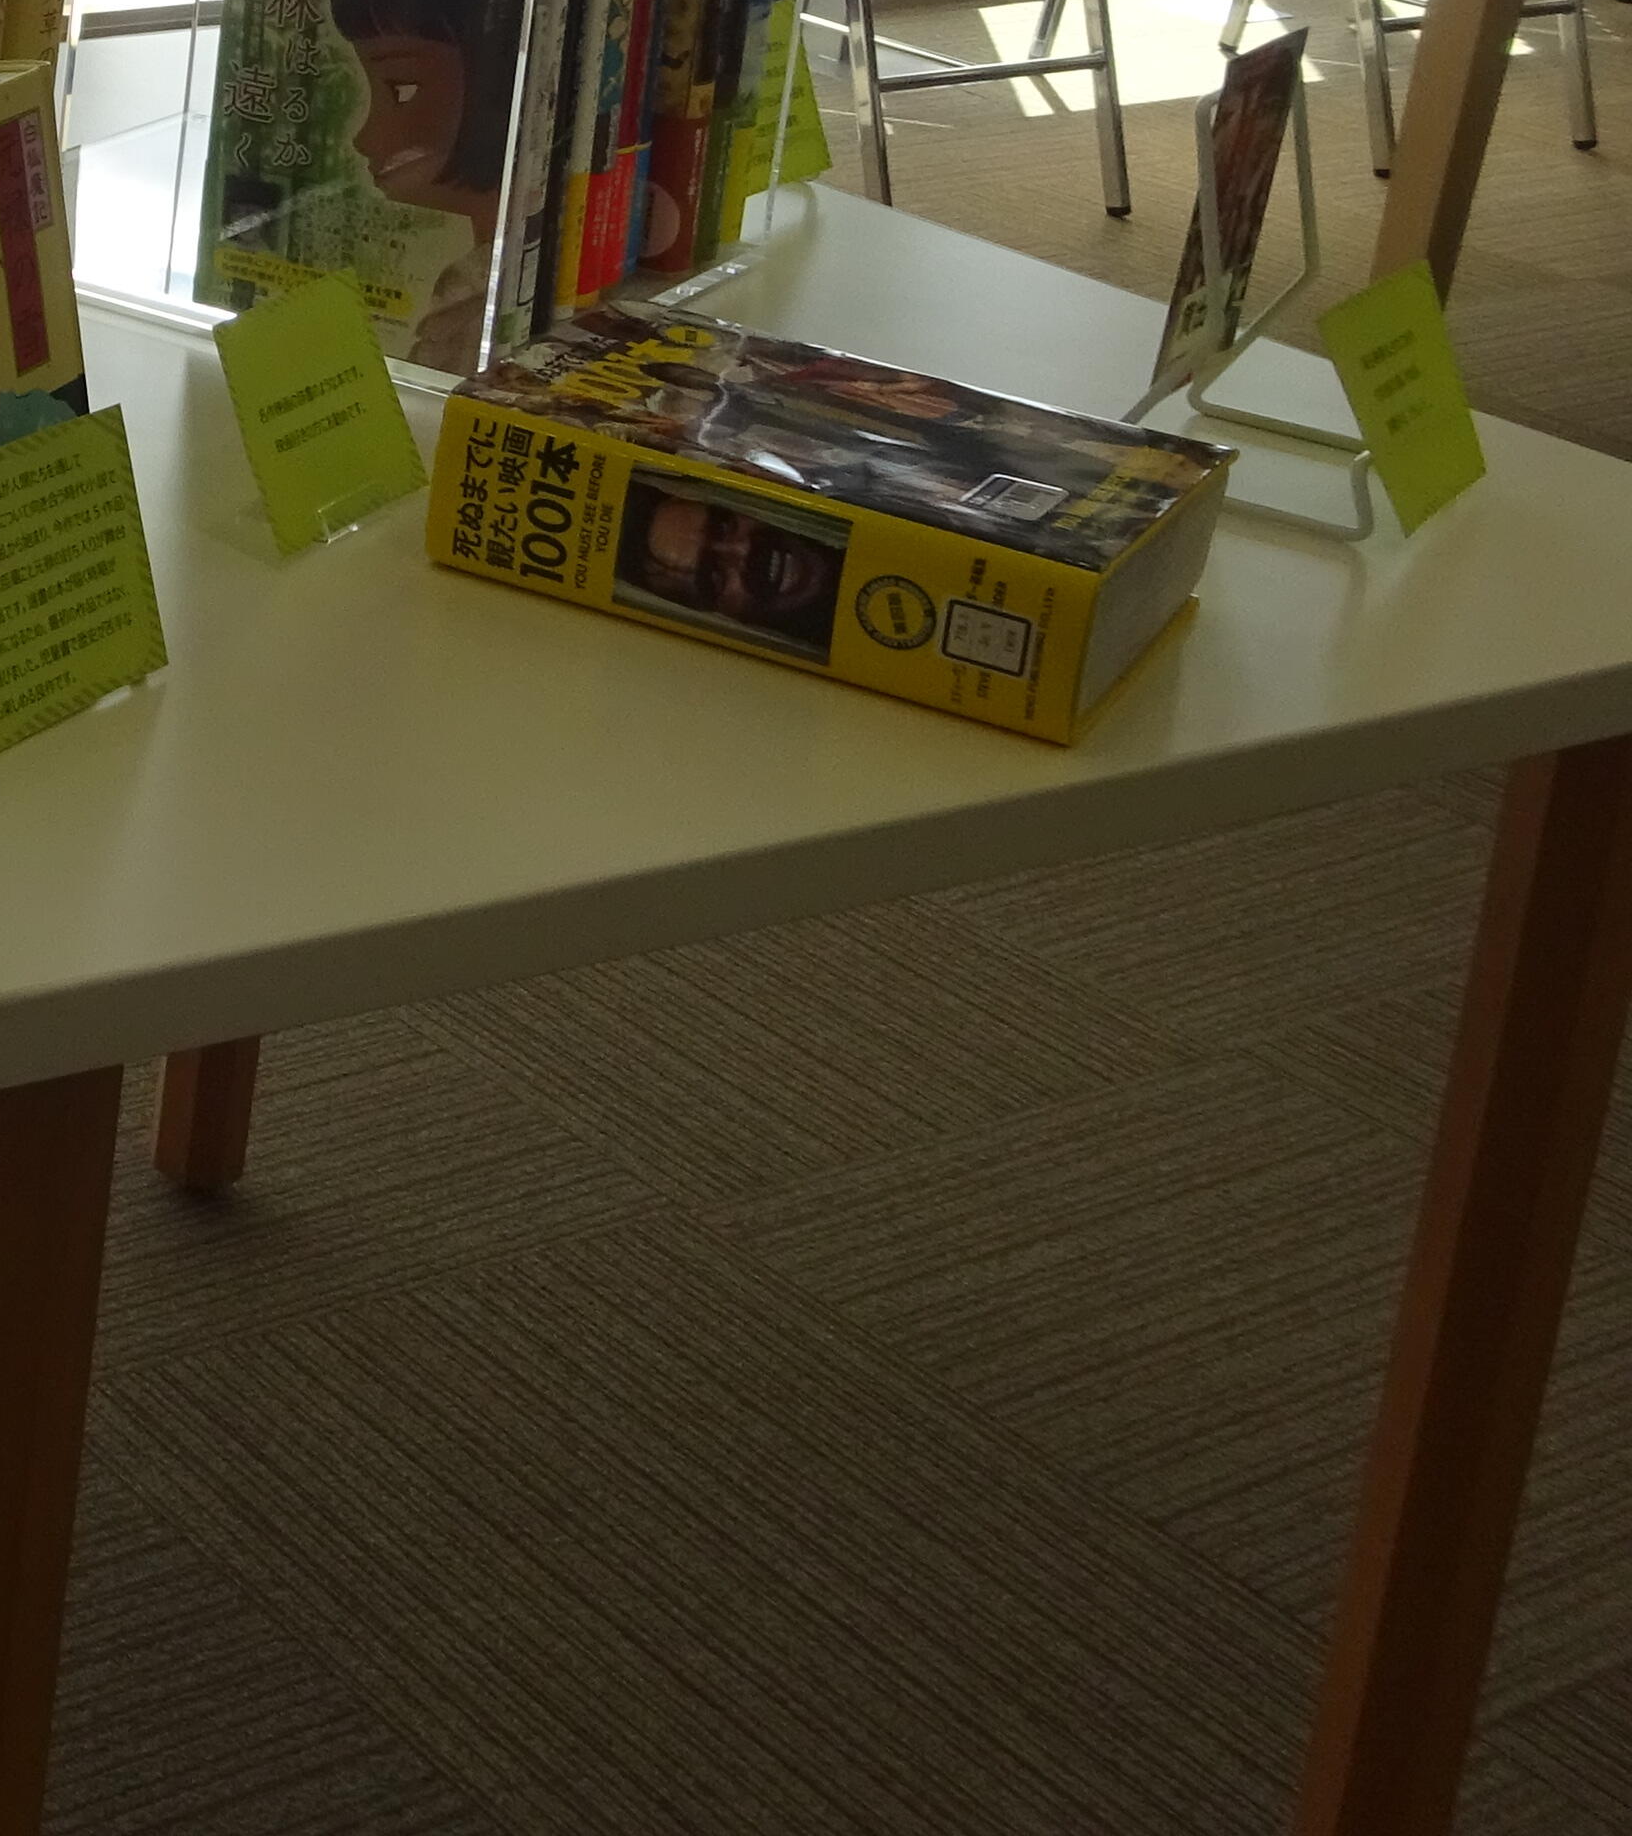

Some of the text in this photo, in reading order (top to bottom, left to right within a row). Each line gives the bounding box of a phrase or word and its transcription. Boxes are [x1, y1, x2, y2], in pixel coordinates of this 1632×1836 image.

[223, 60, 278, 168] 遠く
[451, 418, 499, 561] 死ぬまでに
[485, 423, 535, 571] 観たい映画
[519, 435, 581, 584] 1001本
[574, 451, 607, 590] YOU MUST SEE BEFORE
[594, 503, 615, 554] YOU DIE
